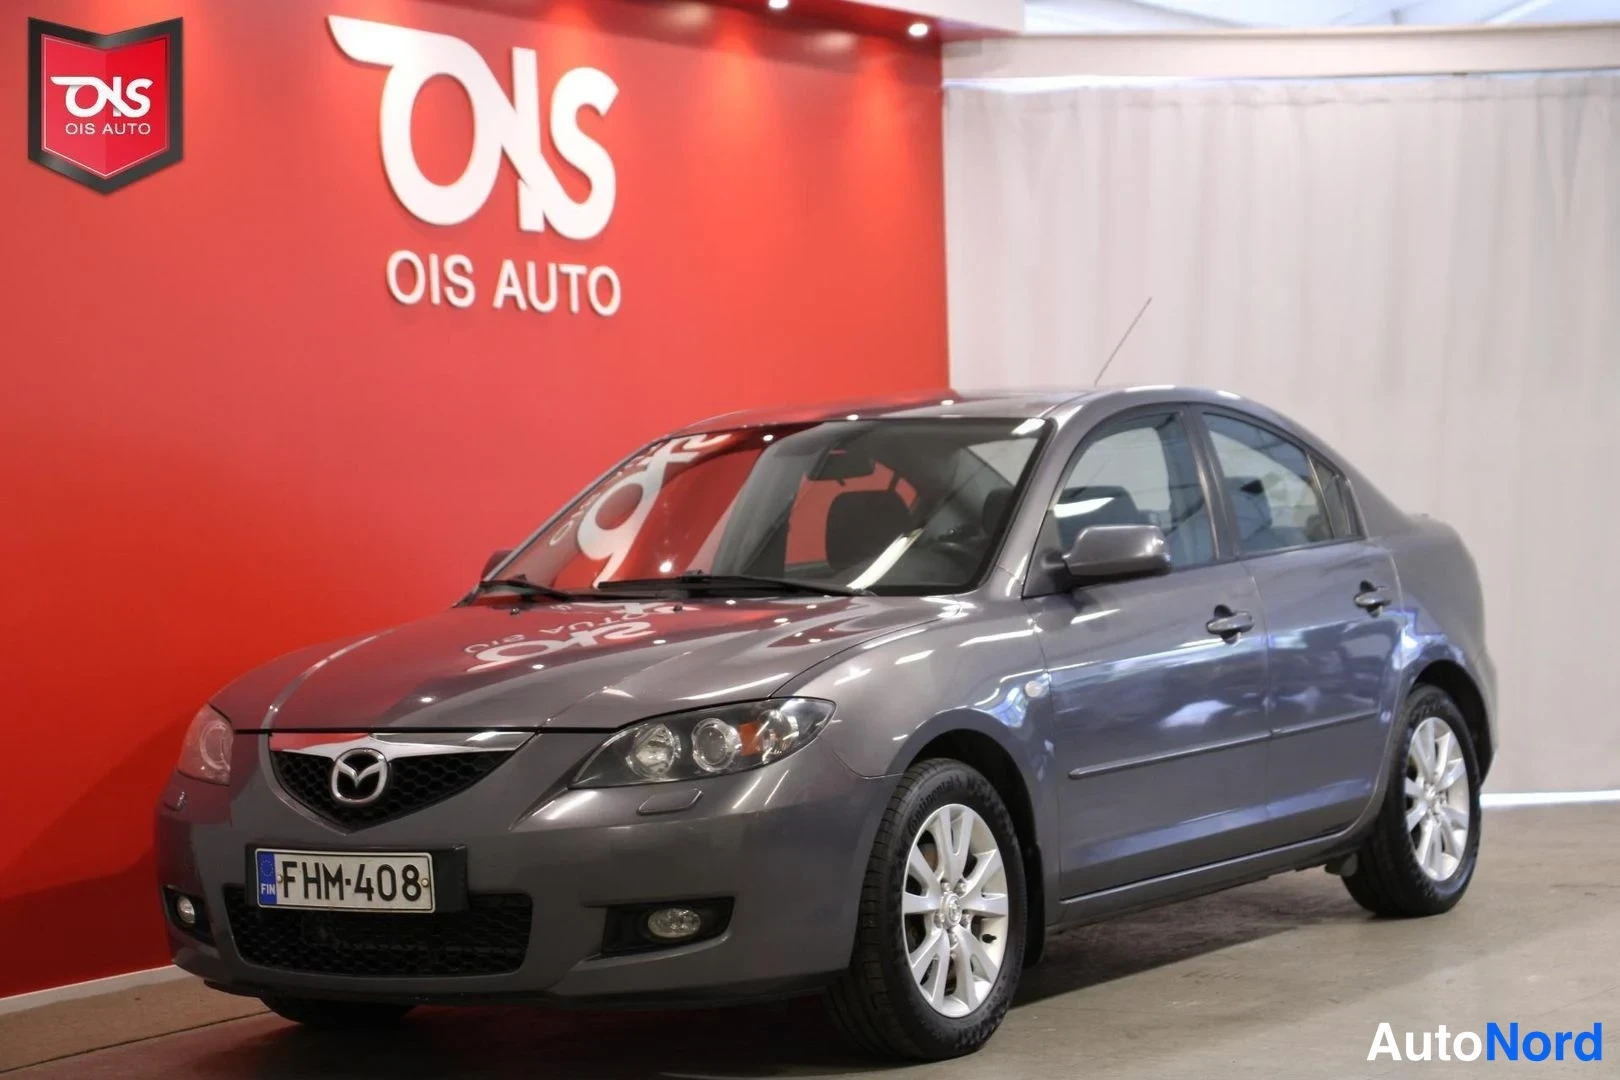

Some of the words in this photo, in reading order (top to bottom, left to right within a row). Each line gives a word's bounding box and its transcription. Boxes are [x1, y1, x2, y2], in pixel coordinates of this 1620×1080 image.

[386, 250, 475, 308] OIS
[492, 259, 621, 317] AUTO
[261, 883, 276, 895] FIN
[282, 861, 422, 901] FHM-408
